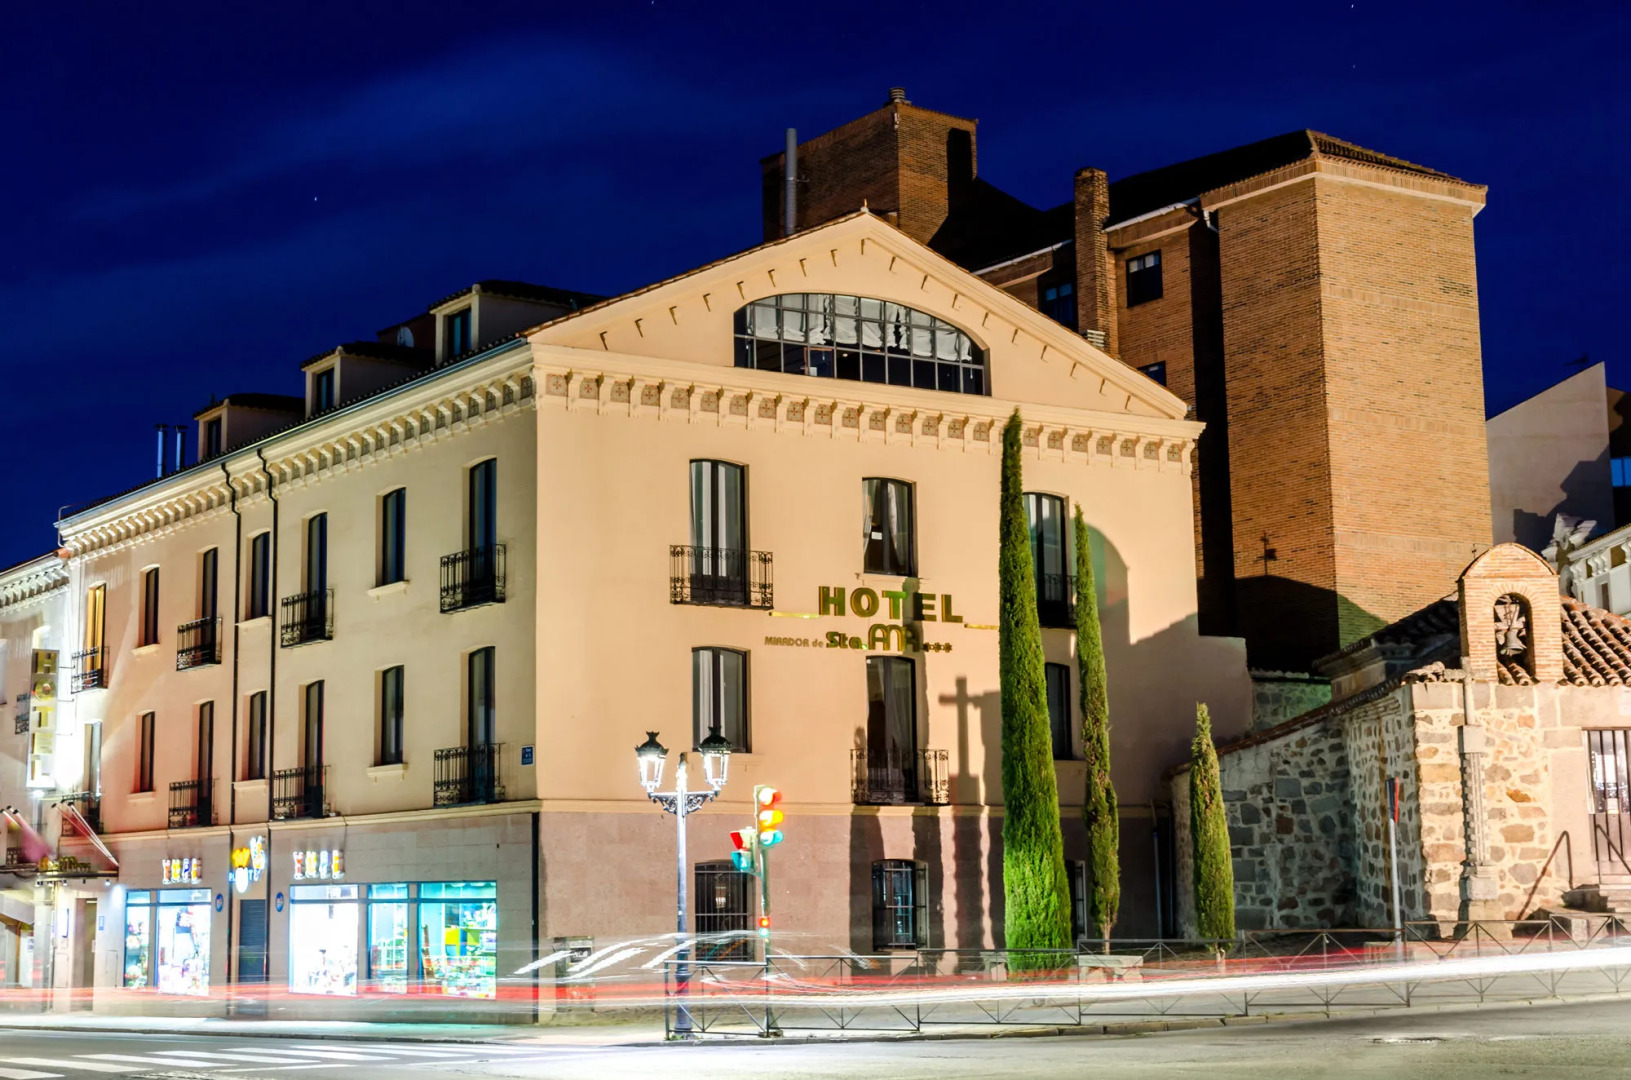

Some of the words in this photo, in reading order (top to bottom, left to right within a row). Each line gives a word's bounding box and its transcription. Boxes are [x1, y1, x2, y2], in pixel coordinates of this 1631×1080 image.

[818, 586, 964, 623] HOTEL
[764, 636, 809, 648] MIRADOR
[812, 638, 824, 648] de
[31, 651, 58, 780] HOTEL
